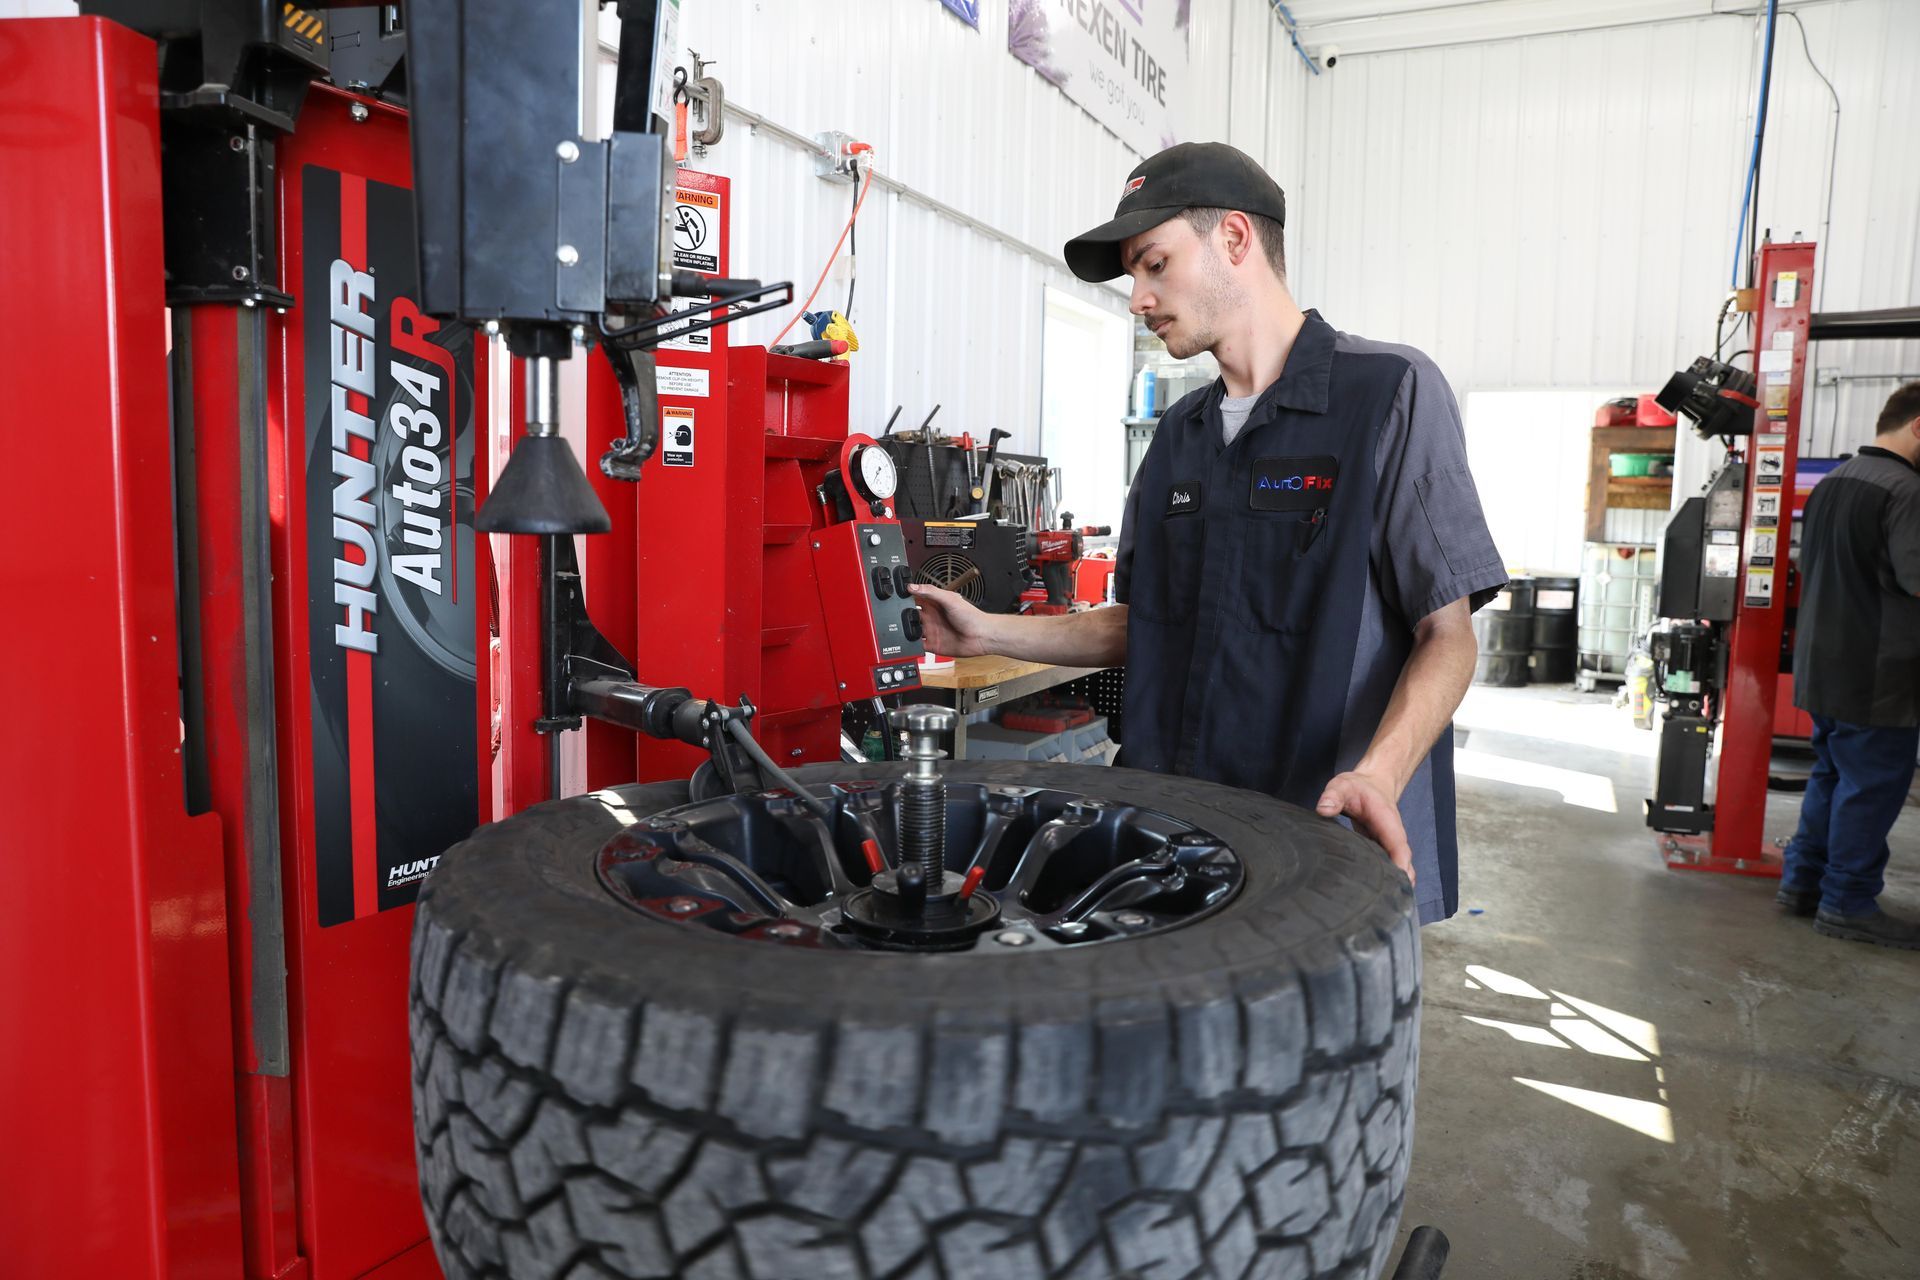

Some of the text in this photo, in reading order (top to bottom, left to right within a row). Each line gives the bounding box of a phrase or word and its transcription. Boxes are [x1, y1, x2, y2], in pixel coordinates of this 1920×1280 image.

[1089, 60, 1144, 126] we got you
[1131, 36, 1166, 108] TIRE
[330, 258, 378, 654] HUNTER
[389, 855, 442, 880] HUNT
